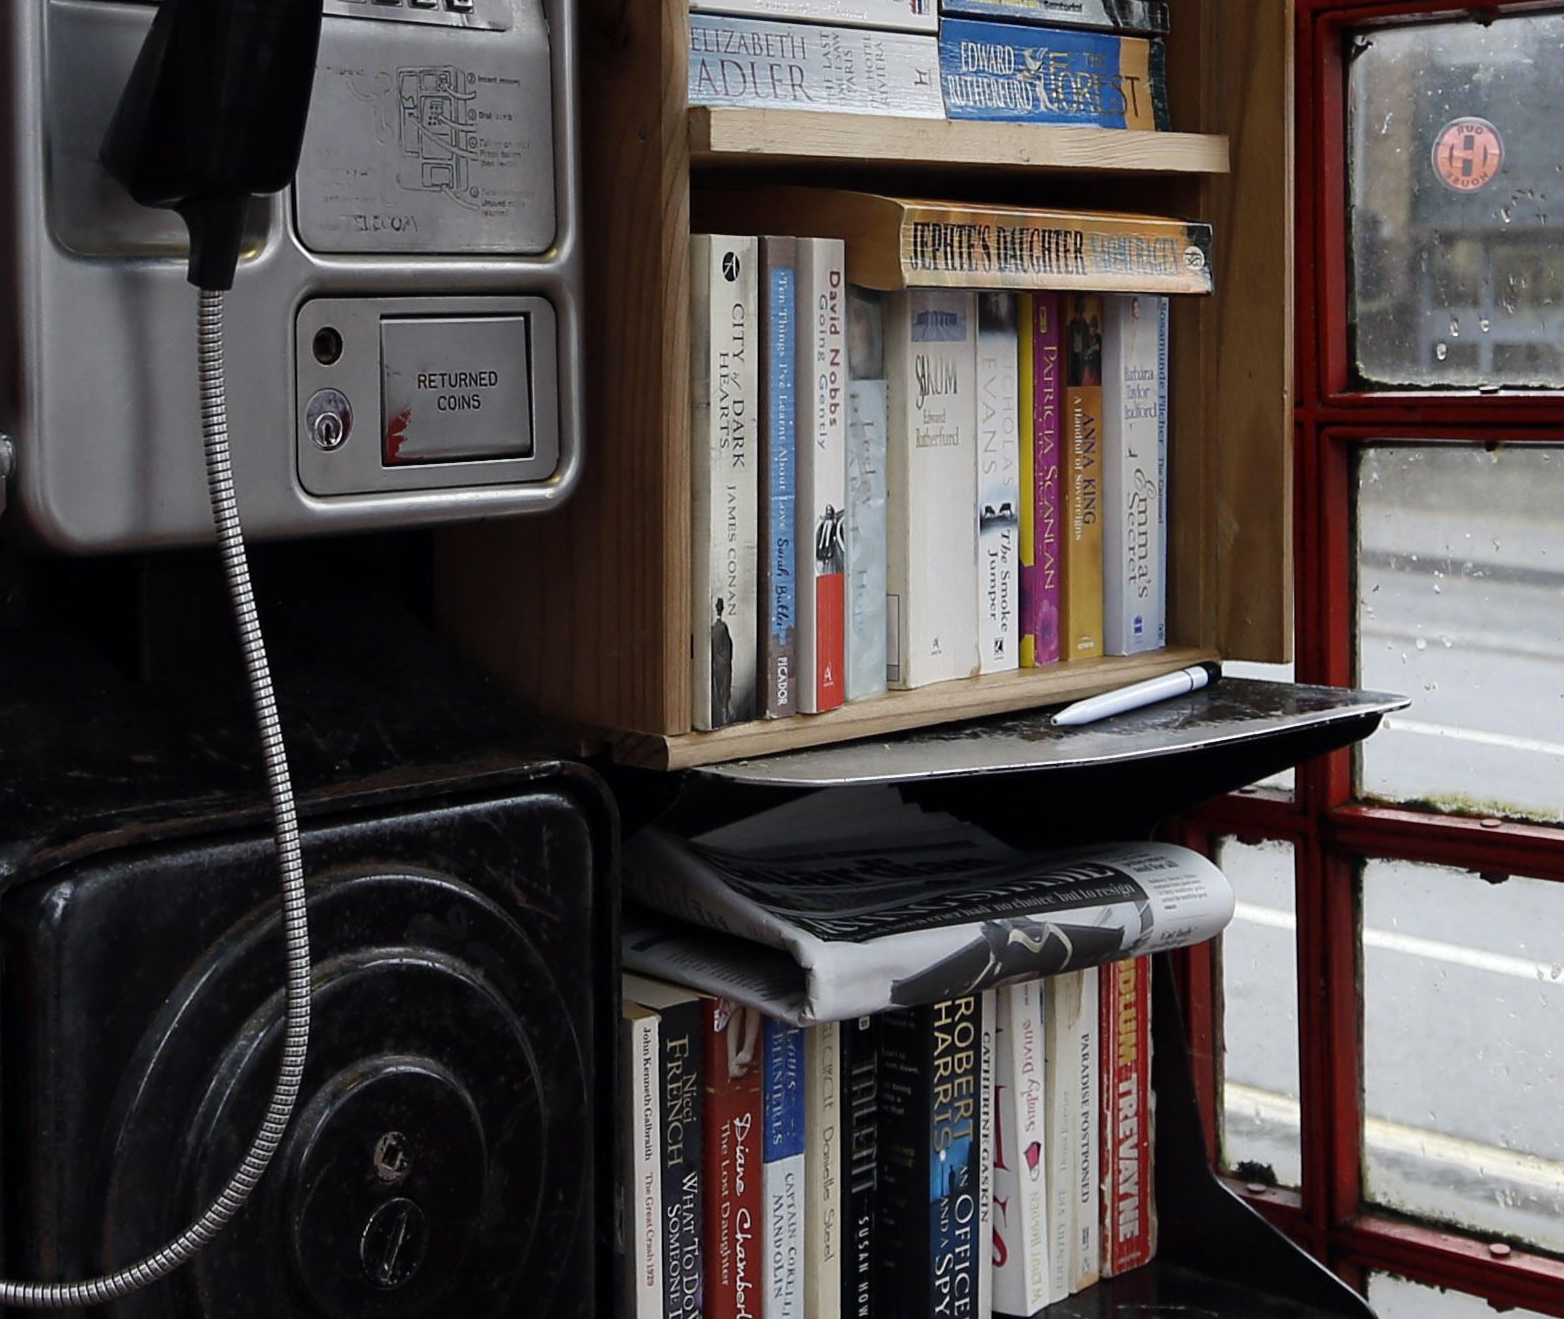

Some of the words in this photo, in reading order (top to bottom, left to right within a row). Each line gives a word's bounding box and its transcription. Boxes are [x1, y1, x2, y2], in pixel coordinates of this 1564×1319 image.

[690, 27, 807, 60] ELIZABETH
[960, 42, 1015, 75] EDWARD
[698, 57, 814, 101] ADLER
[1049, 52, 1140, 117] FOREST
[910, 222, 992, 271] JEPHTE'S
[996, 225, 1087, 275] DAUGHTER
[732, 303, 745, 362] CITY
[818, 294, 827, 362] Going
[829, 271, 841, 335] David
[418, 371, 498, 389] RETURNED
[437, 394, 481, 411] COINS
[719, 352, 729, 448] HEARTS
[829, 349, 841, 426] Nobbs
[1043, 346, 1057, 454] PATRICIA
[733, 400, 745, 468] DARK
[818, 374, 827, 449] Gently
[983, 358, 996, 475] EVANS
[1002, 344, 1014, 487] NICHOLAS
[1074, 409, 1082, 454] Handful
[1082, 413, 1095, 469] ANNA
[727, 485, 736, 542] JAMES
[1043, 465, 1058, 590] SCANLAN
[1083, 478, 1096, 525] KING
[1001, 529, 1010, 562] The
[1127, 492, 1137, 584] Secret
[1136, 468, 1156, 598] Emma's
[728, 548, 736, 616] CONAN
[988, 550, 996, 621] Jumper
[1000, 570, 1010, 632] Smoke
[778, 657, 788, 706] PICADOR
[643, 1028, 652, 1055] John
[954, 996, 974, 1142] ROBERT
[1022, 1019, 1033, 1076] Divine
[1081, 1034, 1090, 1108] PARADISE
[644, 1058, 653, 1106] Kenneth
[667, 1035, 689, 1168] FRENCH
[683, 1075, 696, 1123] Nicci
[933, 1000, 952, 1152] HARRIS
[981, 1032, 991, 1145] CATHERINE
[1019, 1078, 1041, 1132] Simply
[644, 1108, 653, 1160] Galbraith
[721, 1121, 730, 1154] The
[733, 1113, 751, 1196] Diane
[852, 1058, 876, 1194] TALENT
[1081, 1111, 1090, 1203] POSTPONED
[645, 1172, 654, 1193] The
[721, 1159, 730, 1196] Lost
[823, 1126, 833, 1201] Danielle
[959, 1163, 969, 1187] AN
[1119, 1074, 1139, 1243] TREVAYNE
[646, 1197, 654, 1227] Great
[682, 1171, 698, 1234] WHAT
[786, 1173, 795, 1239] CAPTAIN
[940, 1197, 949, 1230] AND
[646, 1229, 654, 1261] Crash
[668, 1205, 682, 1305] SOMEONE
[720, 1201, 730, 1286] Daughter
[772, 1195, 784, 1299] MANDOLIN
[823, 1208, 834, 1261] Steel
[858, 1216, 869, 1273] SUSAN
[940, 1238, 948, 1248] A
[934, 1254, 954, 1314] SPY
